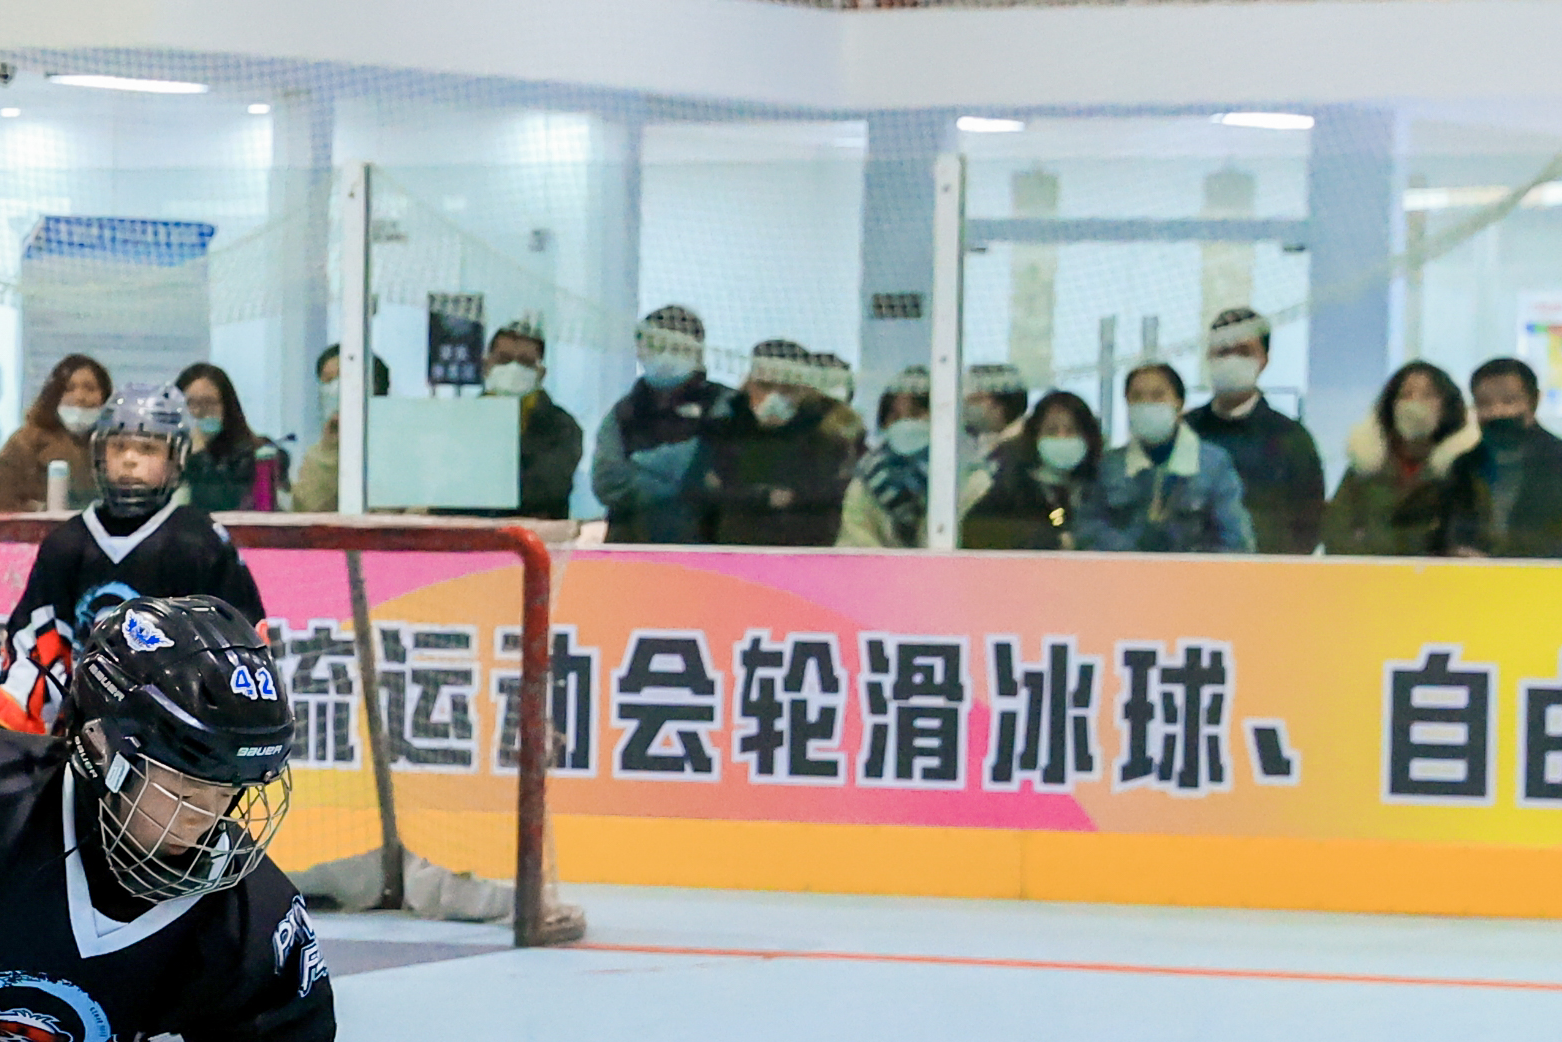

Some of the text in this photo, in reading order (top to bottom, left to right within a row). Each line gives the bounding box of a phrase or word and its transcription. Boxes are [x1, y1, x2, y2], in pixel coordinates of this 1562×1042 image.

[89, 664, 126, 702] BAUER
[229, 665, 278, 700] 42
[73, 735, 99, 779] BAUER
[236, 745, 284, 757] BAUER
